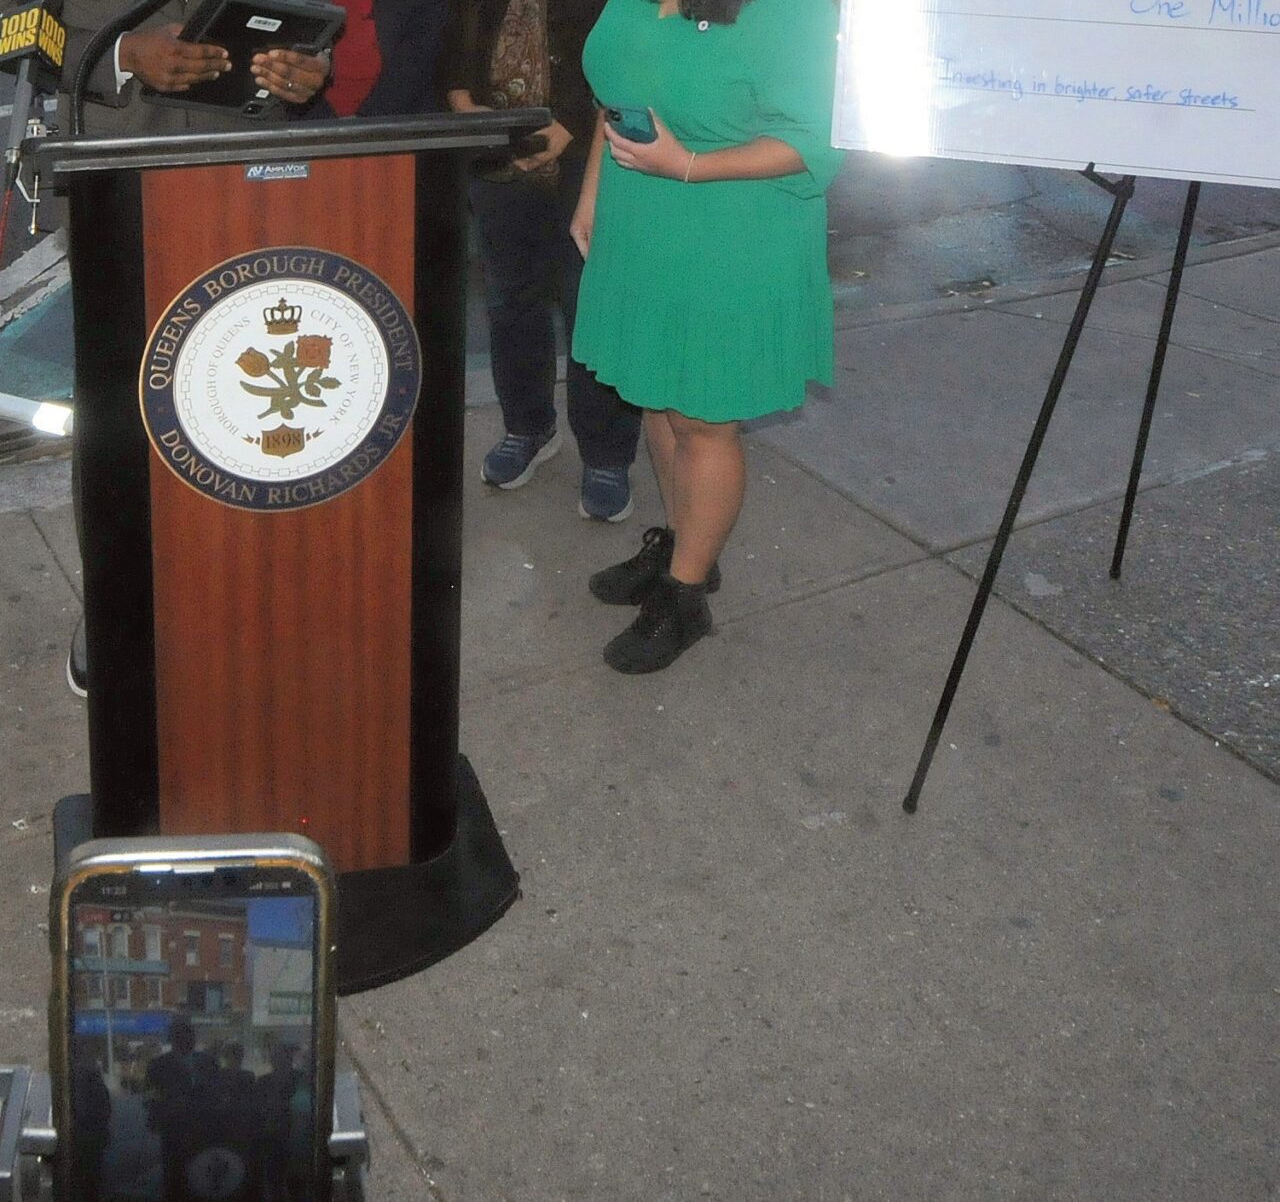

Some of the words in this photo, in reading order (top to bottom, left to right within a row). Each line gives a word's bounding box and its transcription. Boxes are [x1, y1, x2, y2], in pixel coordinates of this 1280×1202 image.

[1, 7, 40, 38] 1010
[41, 8, 66, 49] 1010
[38, 28, 63, 67] WINS
[1032, 78, 1046, 93] in
[149, 298, 202, 391] QUEENS
[202, 255, 326, 299] BOROUGH
[334, 265, 413, 371] PRESIDENT
[310, 308, 340, 332] CITY
[215, 316, 252, 360] QUEENS
[340, 332, 354, 351] OF
[208, 359, 218, 377] OF
[347, 352, 360, 385] NEW
[208, 378, 239, 436] BOROUGH
[329, 388, 357, 426] YORK
[266, 432, 301, 448] 1898
[160, 429, 257, 503] DONOVAN
[267, 443, 382, 505] RICHARDS
